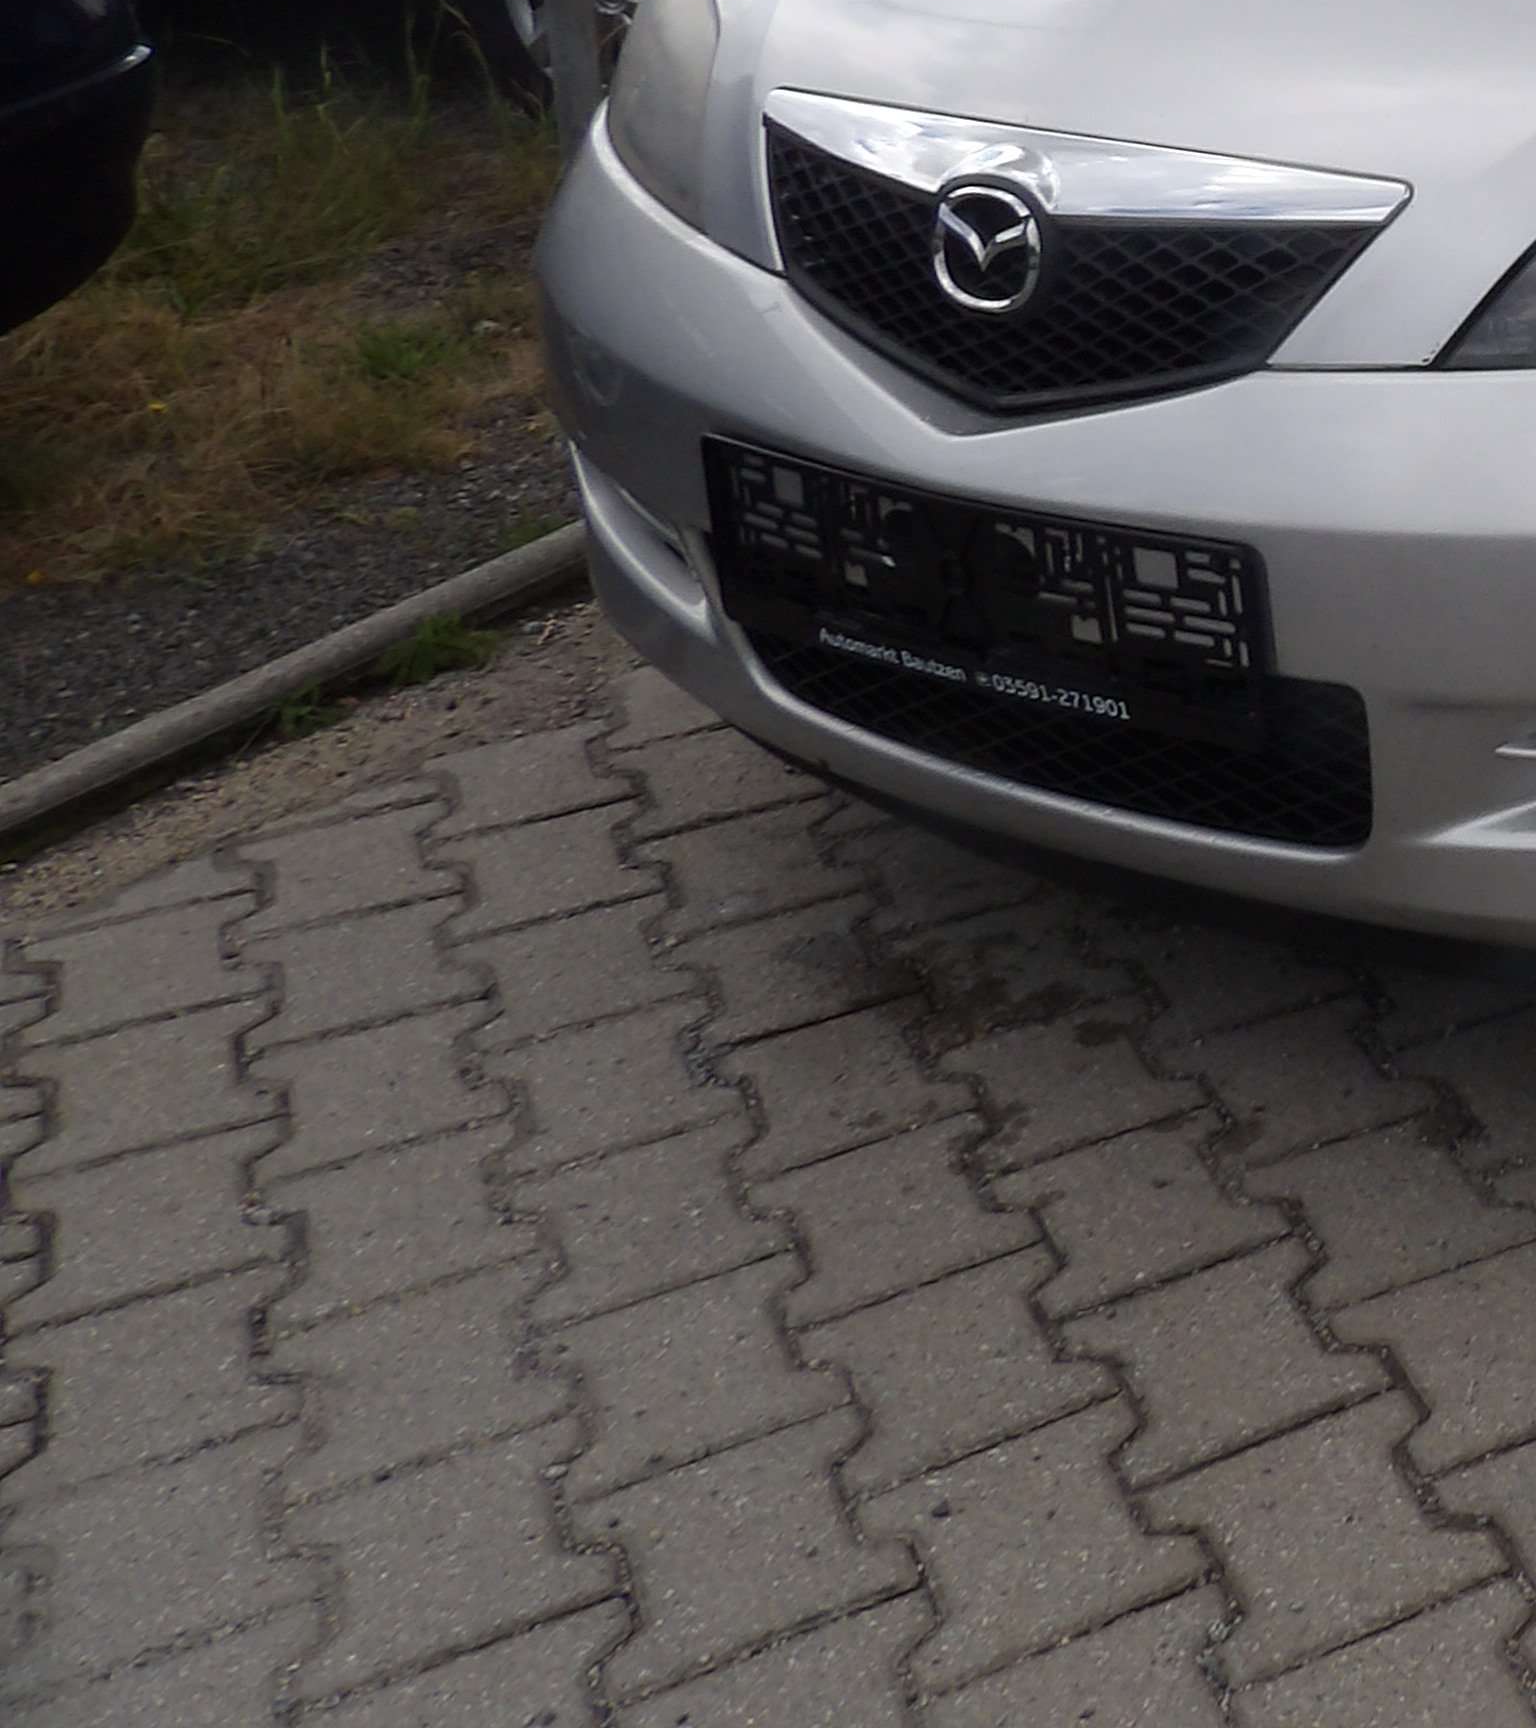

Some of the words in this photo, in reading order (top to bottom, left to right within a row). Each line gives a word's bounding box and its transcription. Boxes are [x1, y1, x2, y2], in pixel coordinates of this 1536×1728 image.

[819, 626, 899, 665] Automarkt
[901, 650, 968, 682] Bautzen
[991, 673, 1131, 720] 03591-271901
